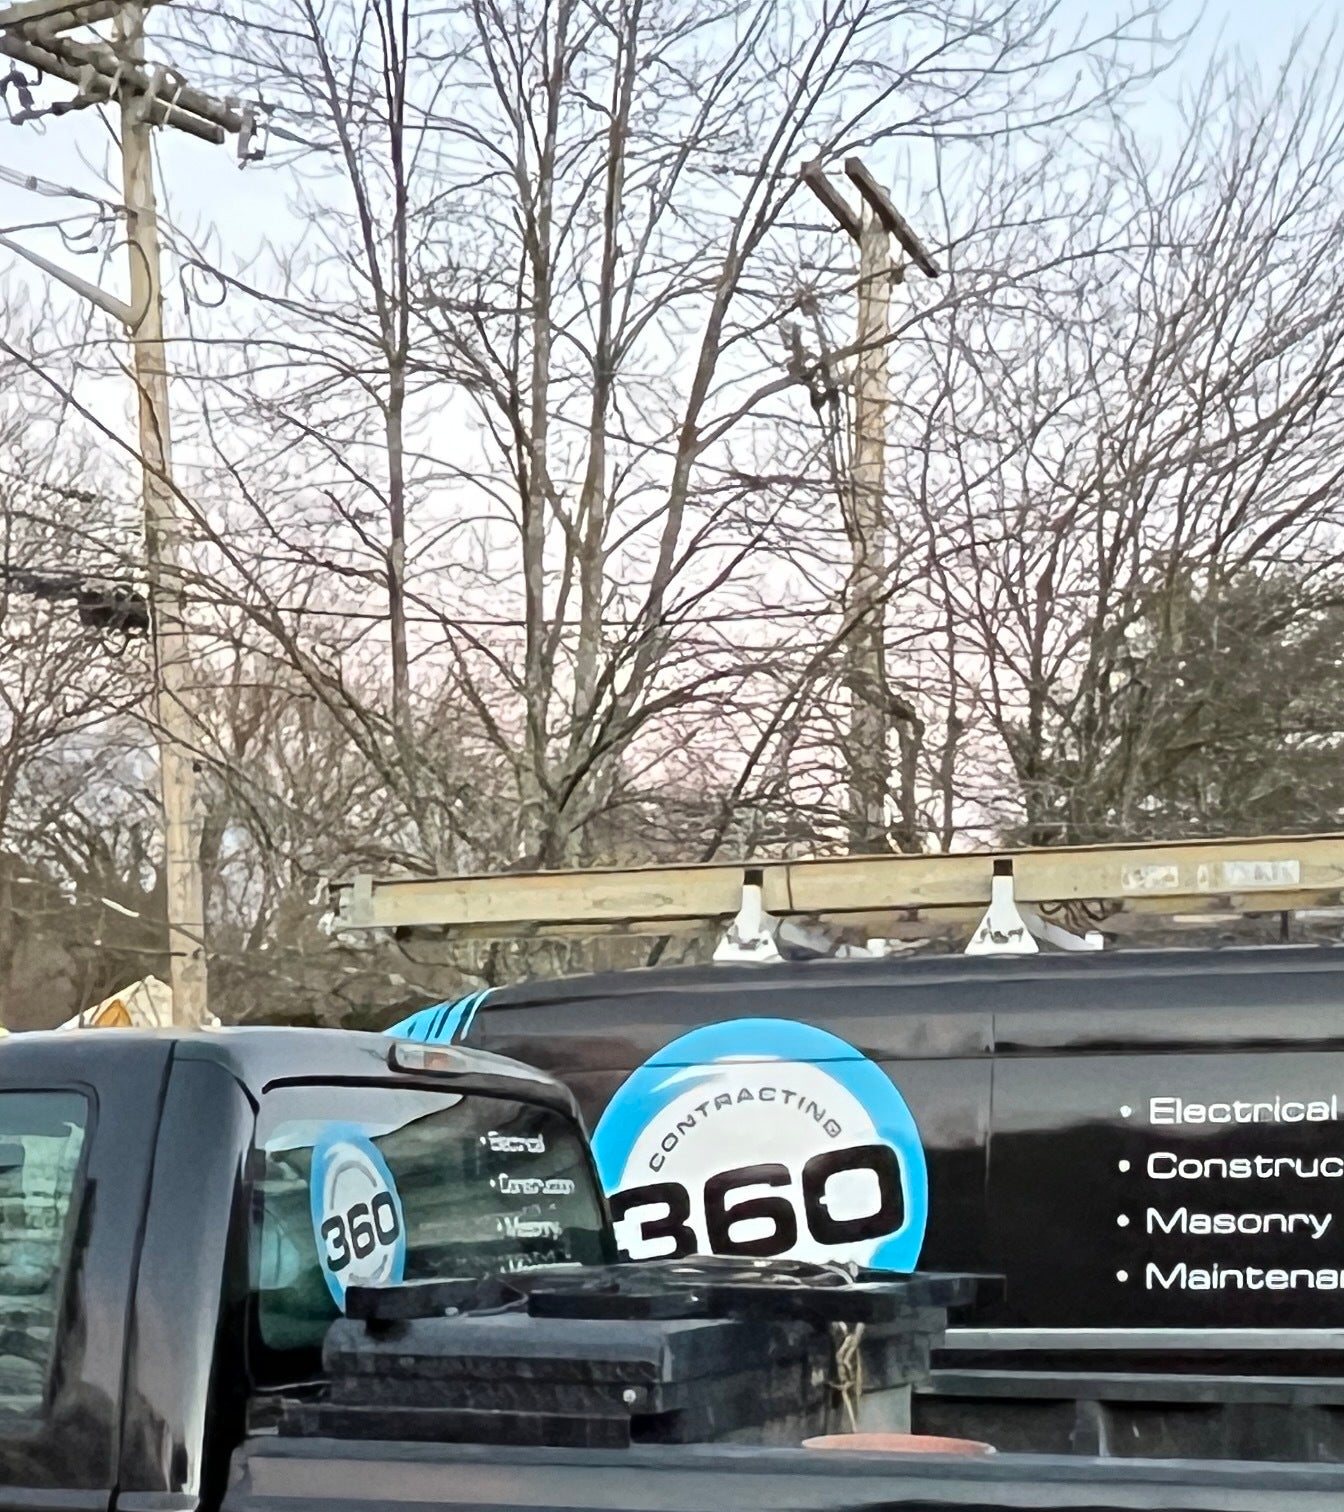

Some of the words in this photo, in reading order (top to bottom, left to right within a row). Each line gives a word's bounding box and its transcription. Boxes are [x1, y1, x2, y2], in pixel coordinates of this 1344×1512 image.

[649, 1086, 843, 1174] CONTRACTING
[1148, 1094, 1339, 1125] Electrical
[321, 1191, 399, 1272] 360
[605, 1143, 905, 1264] 360
[1146, 1207, 1333, 1240] Masonry
